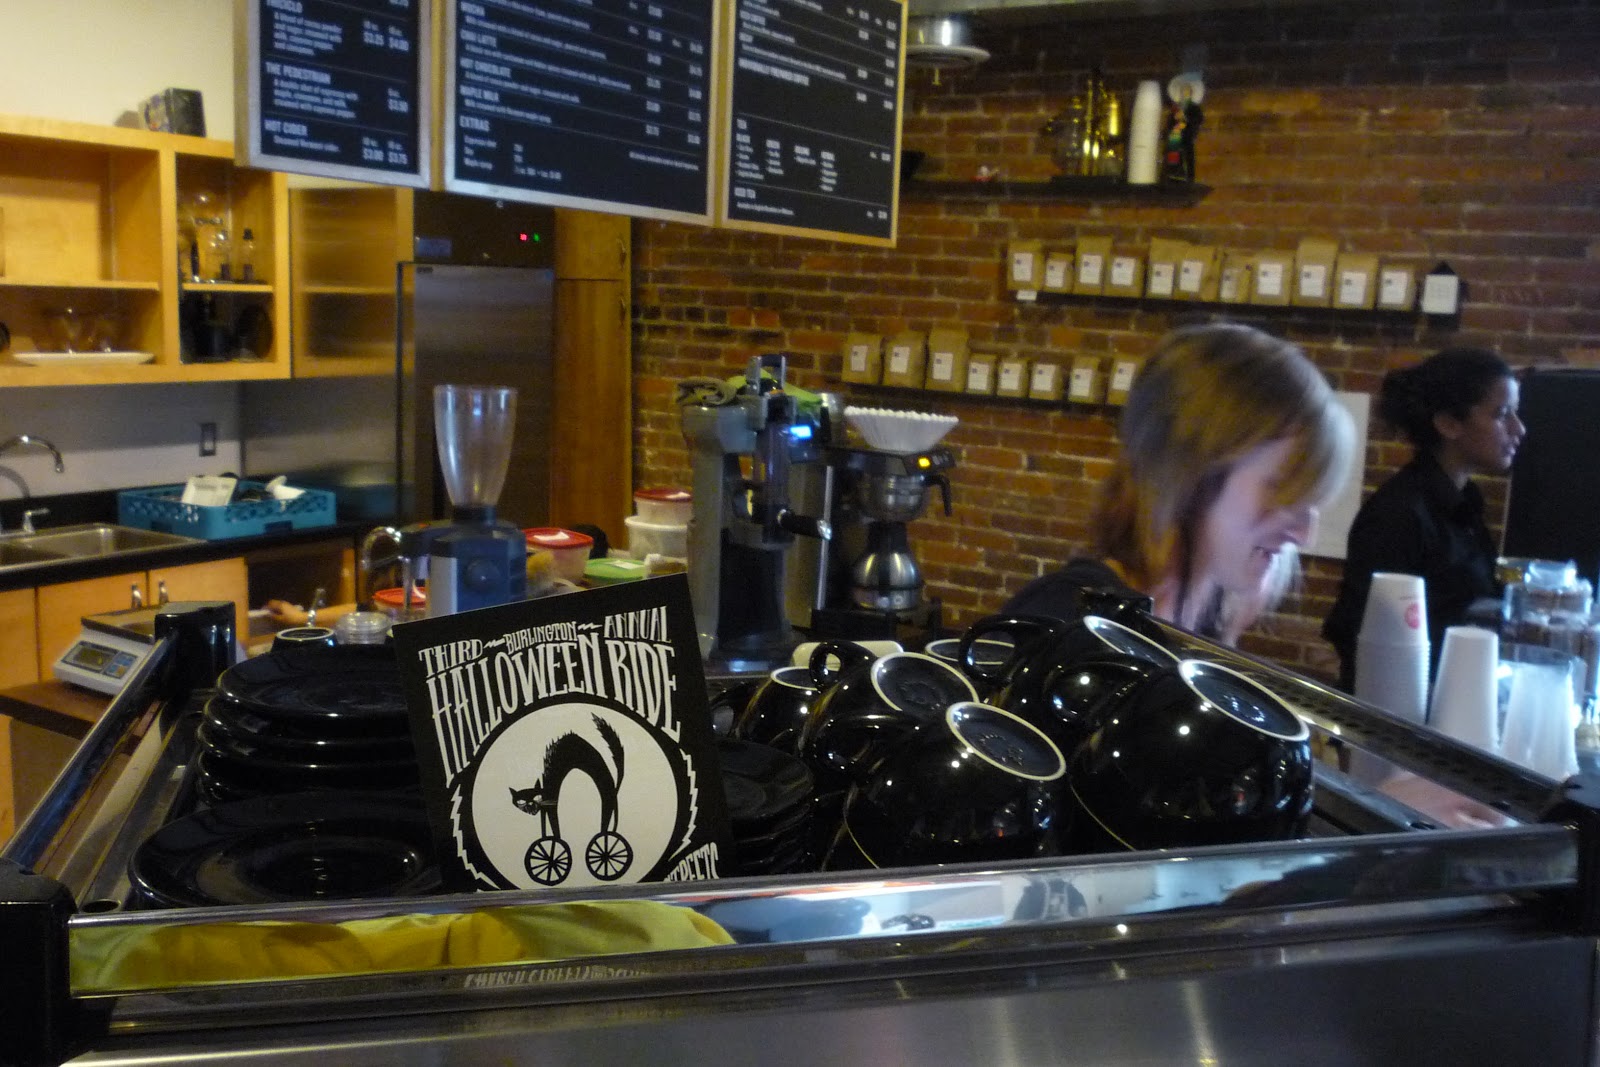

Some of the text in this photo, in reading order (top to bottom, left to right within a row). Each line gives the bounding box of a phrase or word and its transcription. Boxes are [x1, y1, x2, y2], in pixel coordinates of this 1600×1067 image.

[265, 61, 281, 75] THE
[264, 119, 308, 137] HOT CIDER
[460, 115, 490, 132] EXTRAS
[418, 606, 672, 678] THIRD BURLINGTON ANNUAL
[426, 632, 681, 788] HALLOWEEN RIDE
[664, 842, 720, 883] TREETS
